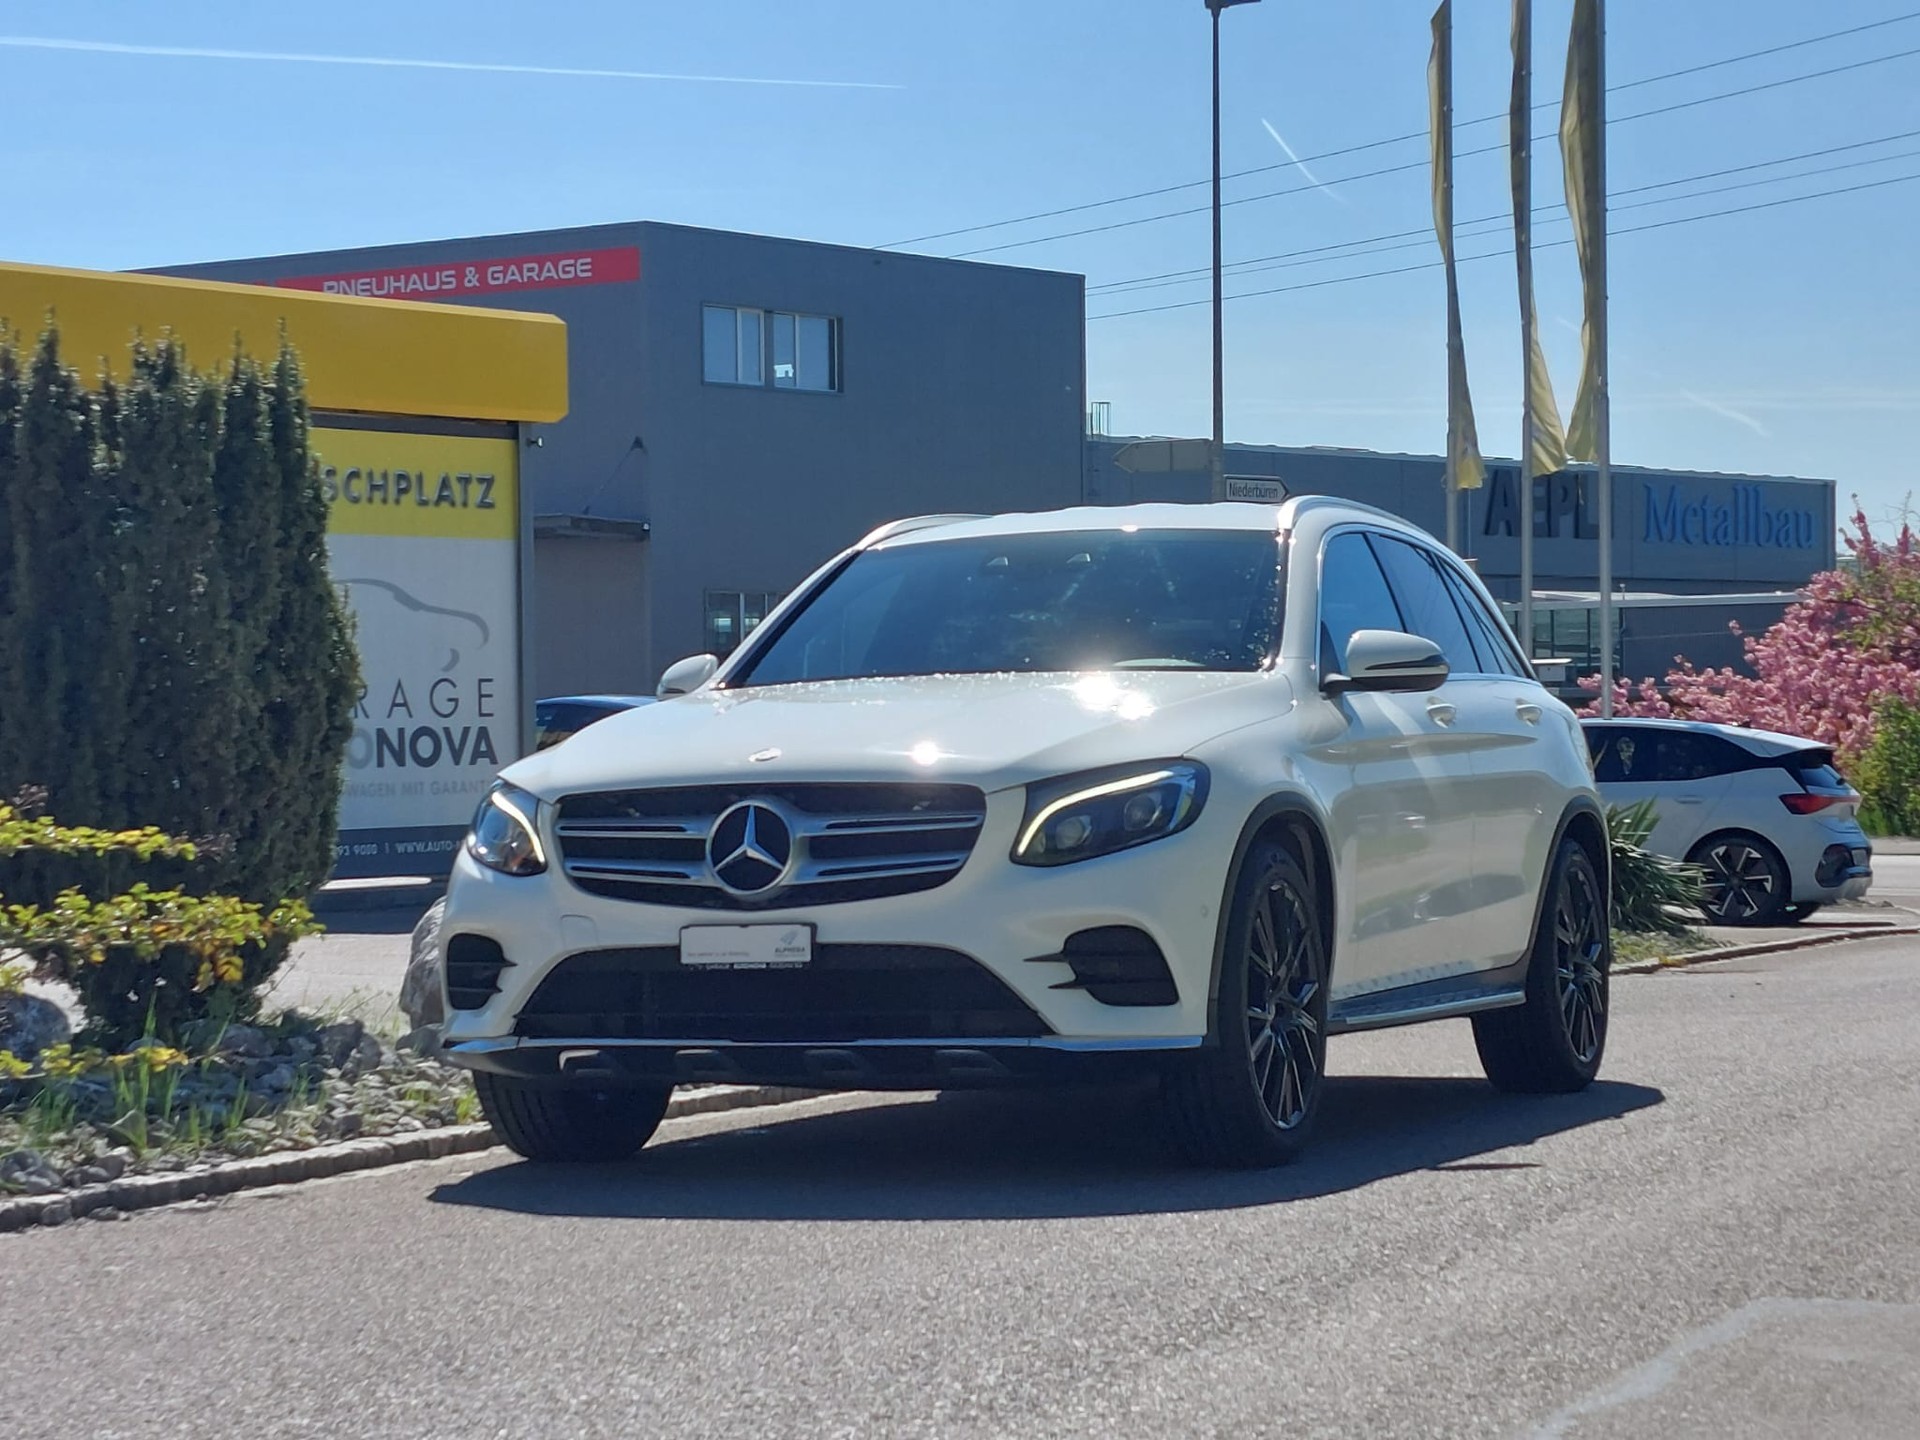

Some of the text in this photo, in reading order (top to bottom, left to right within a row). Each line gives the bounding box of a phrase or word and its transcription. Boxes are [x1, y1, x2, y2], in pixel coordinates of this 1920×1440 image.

[323, 257, 592, 296] PNEUHAUS & GARAGE
[1483, 468, 1816, 549] AEPL Metallbau
[401, 781, 424, 797] MIT
[430, 779, 487, 796] GARANT
